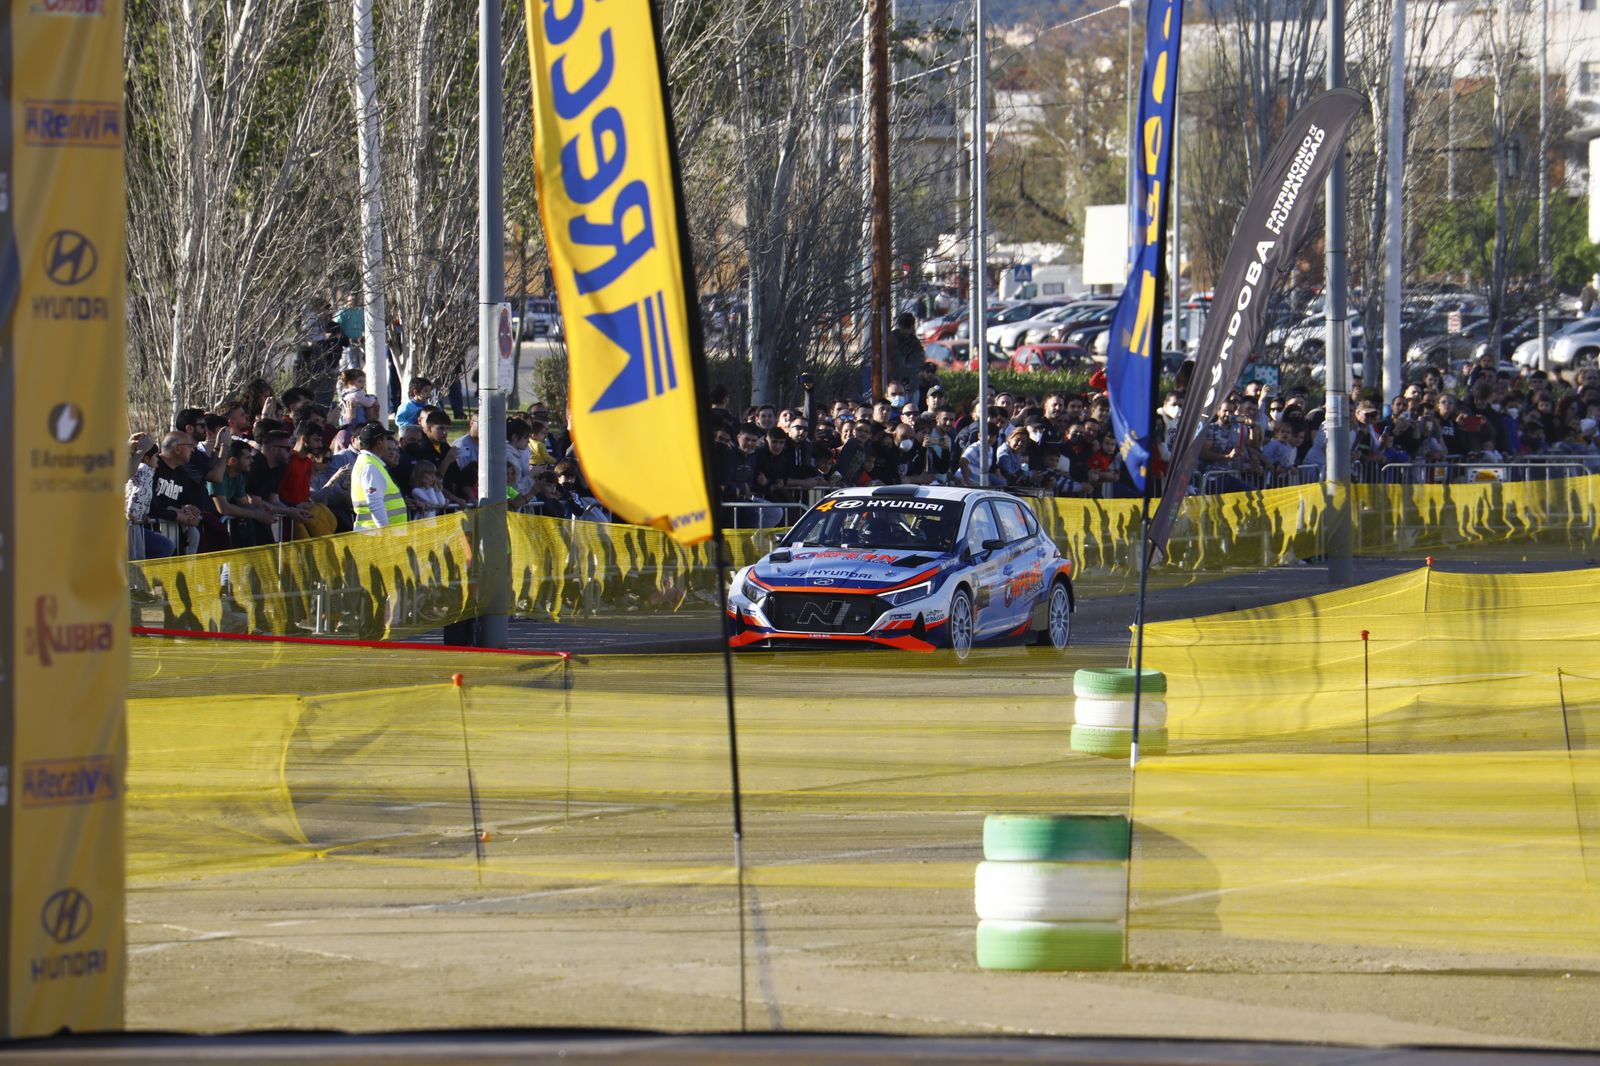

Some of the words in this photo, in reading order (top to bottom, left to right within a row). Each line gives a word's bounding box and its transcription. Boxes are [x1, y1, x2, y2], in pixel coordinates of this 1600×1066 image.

[1265, 135, 1313, 231] PATRIMONIO
[1272, 129, 1326, 235] HUMANIDAD
[816, 500, 837, 512] 4
[866, 500, 944, 512] HYUNDAI
[812, 569, 872, 579] HYUNDAI
